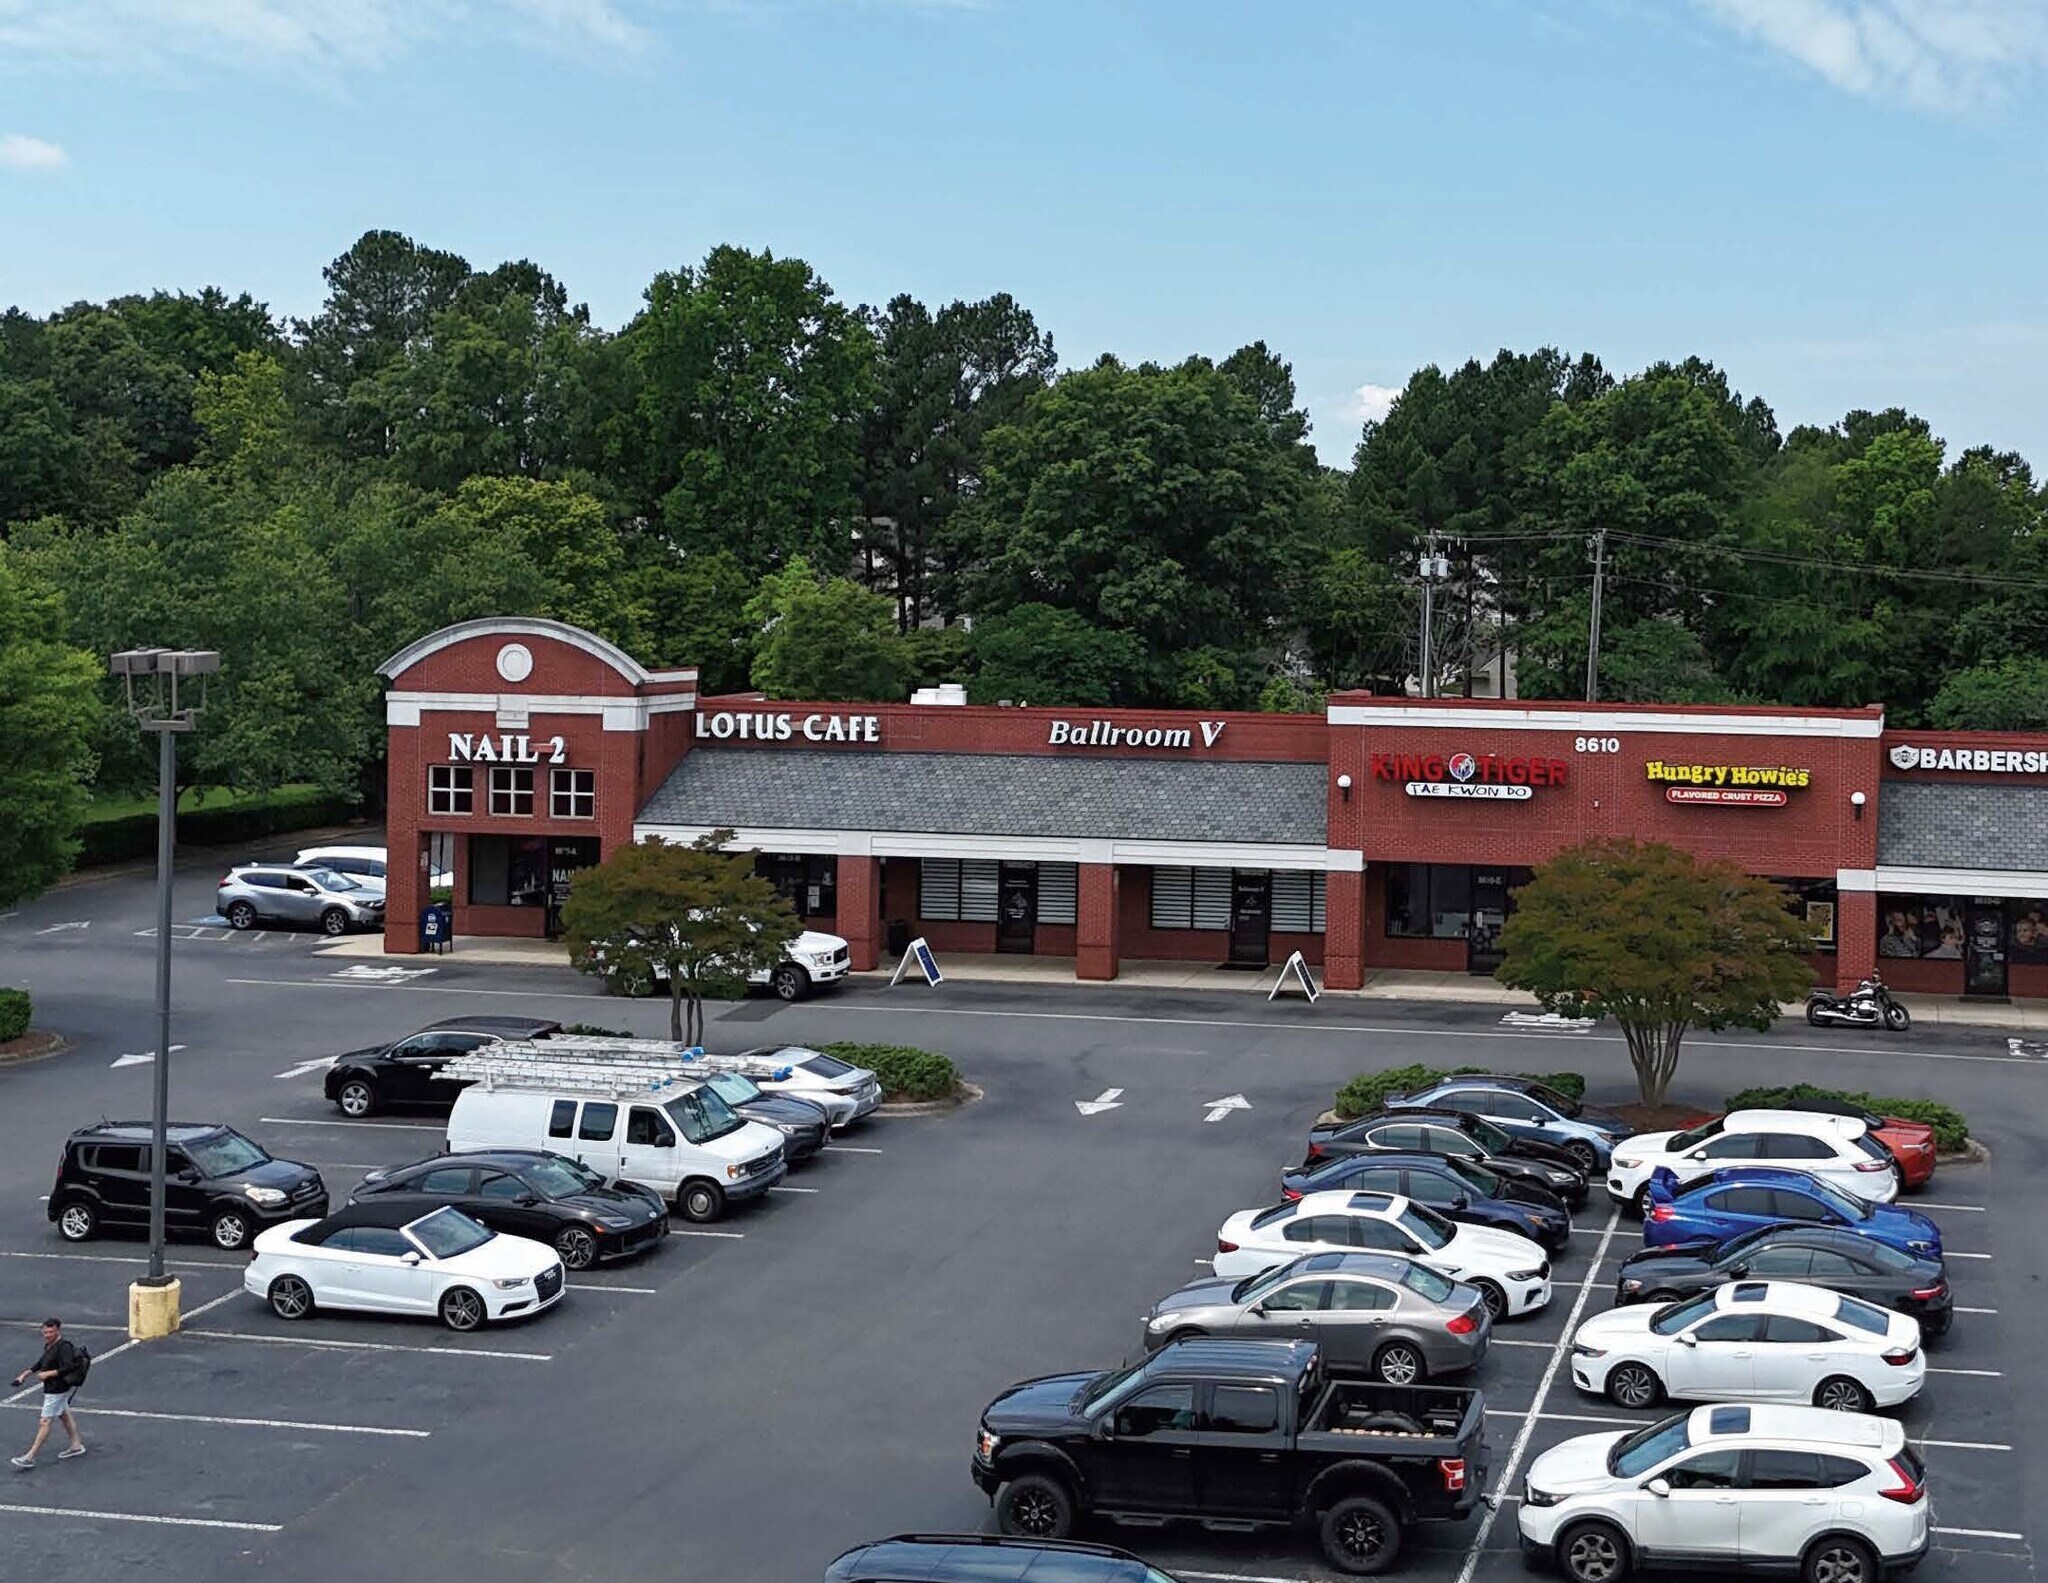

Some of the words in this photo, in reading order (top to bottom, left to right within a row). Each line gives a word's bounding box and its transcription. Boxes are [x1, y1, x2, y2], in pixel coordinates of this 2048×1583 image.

[695, 712, 792, 741] LOTUS
[803, 714, 880, 743] CAFE
[1049, 720, 1192, 748] Ballroom
[1199, 721, 1226, 748] V
[447, 733, 539, 763] NAIL
[548, 736, 566, 764] 2
[1574, 737, 1621, 754] 8610
[1371, 752, 1444, 783] KING
[1478, 755, 1569, 787] TIGER
[1646, 761, 1728, 786] Hungry
[1731, 766, 1810, 787] Howie's
[1410, 783, 1441, 795] TAE
[1447, 784, 1499, 797] KWON
[1507, 785, 1528, 797] DO
[1671, 790, 1721, 800] FLAVORED
[1721, 791, 1752, 801] CRUST
[1753, 792, 1782, 802] PIZZA
